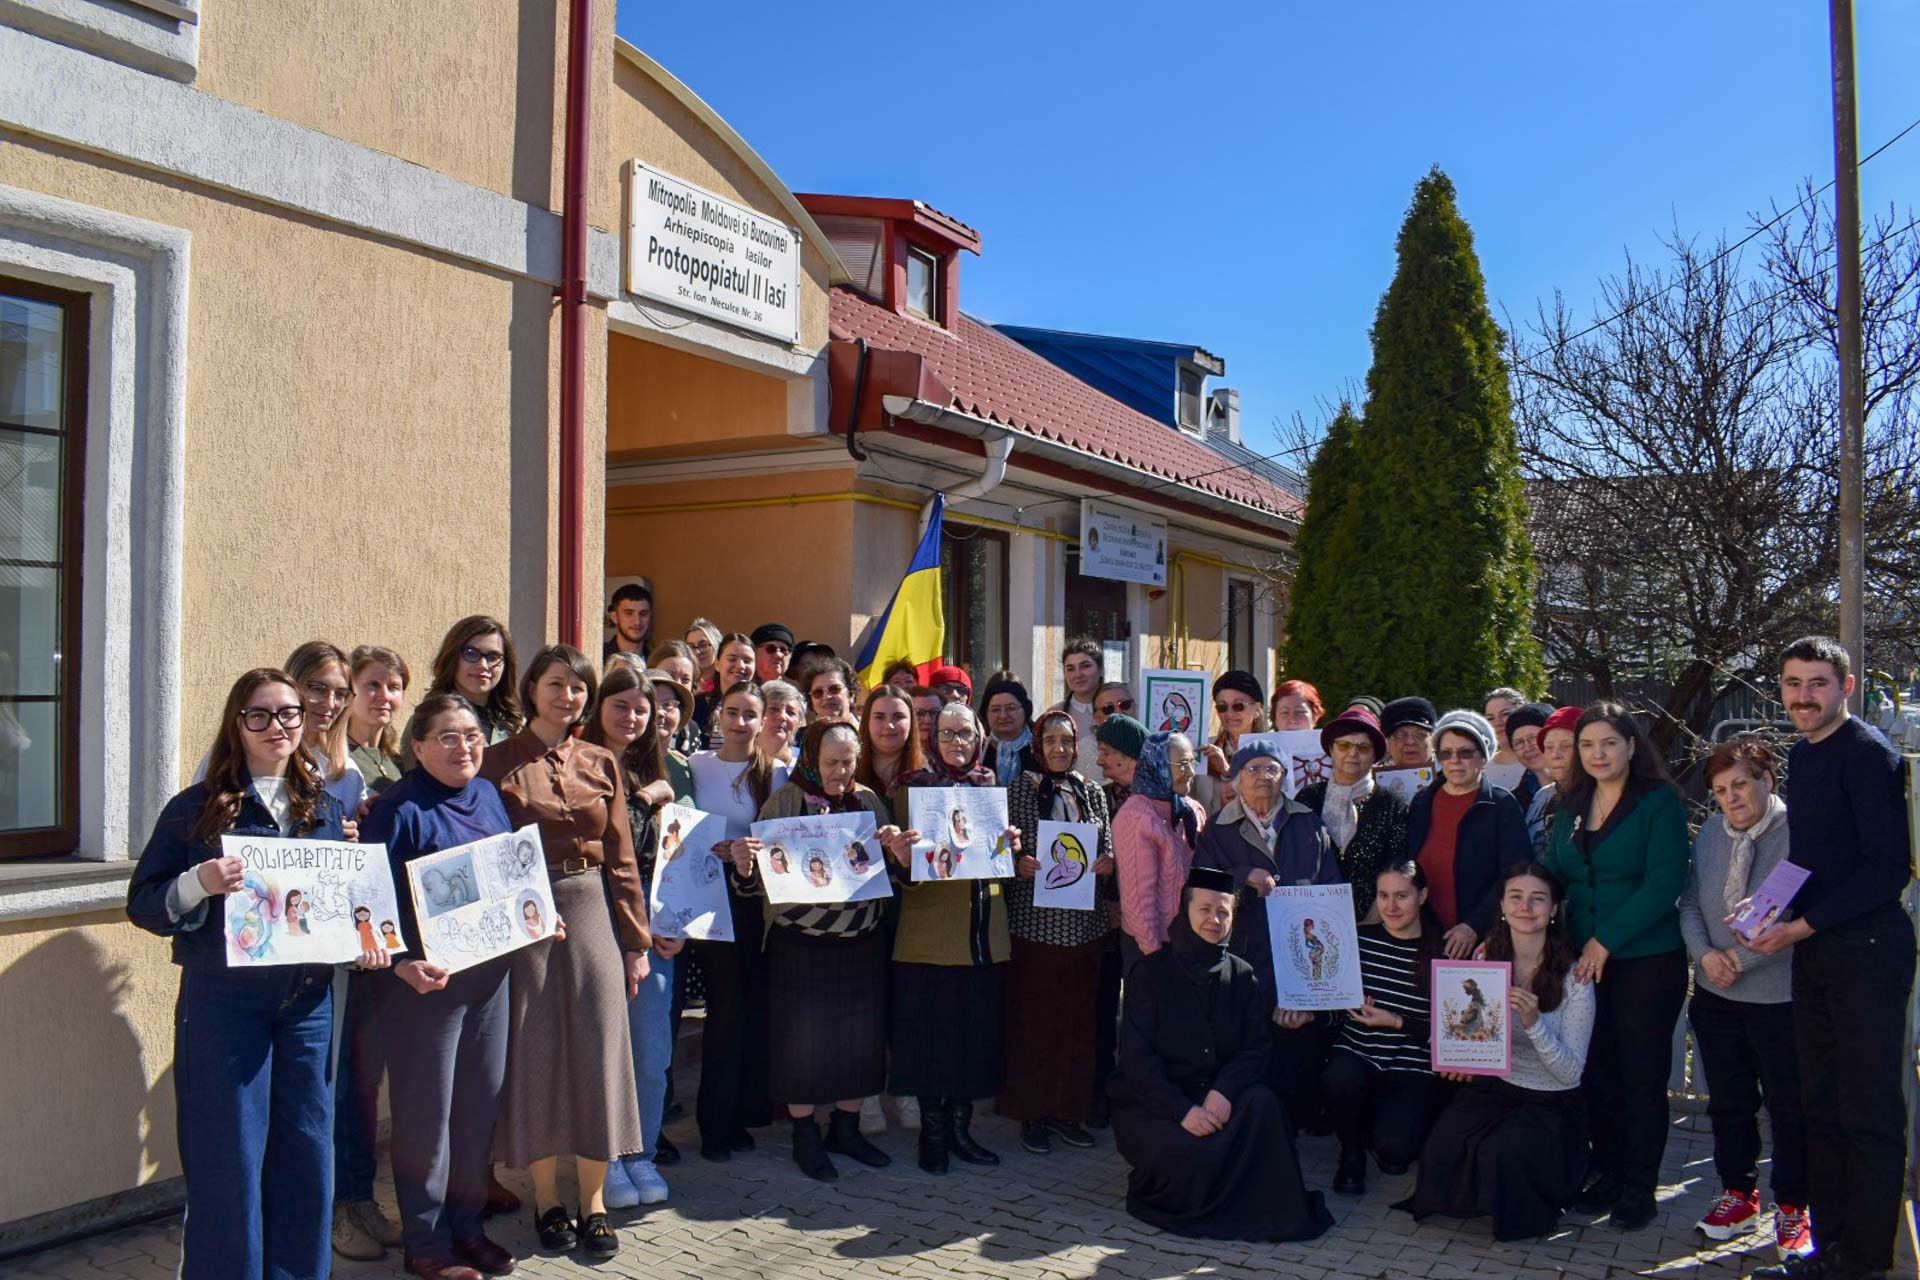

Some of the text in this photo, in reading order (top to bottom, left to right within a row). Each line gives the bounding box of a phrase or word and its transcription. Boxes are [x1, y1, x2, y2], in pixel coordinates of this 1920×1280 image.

[648, 179, 788, 254] Mitropolia Moldovei si Bucovinei
[664, 217, 772, 269] Arhiepiscopia Iasilor
[648, 235, 786, 309] Protopopiatul II Iasi
[677, 285, 691, 299] Str.
[693, 290, 707, 303] Ion
[741, 307, 751, 318] Nr.
[241, 845, 366, 871] SOLIDARITATE
[1274, 887, 1315, 898] DREPTUL
